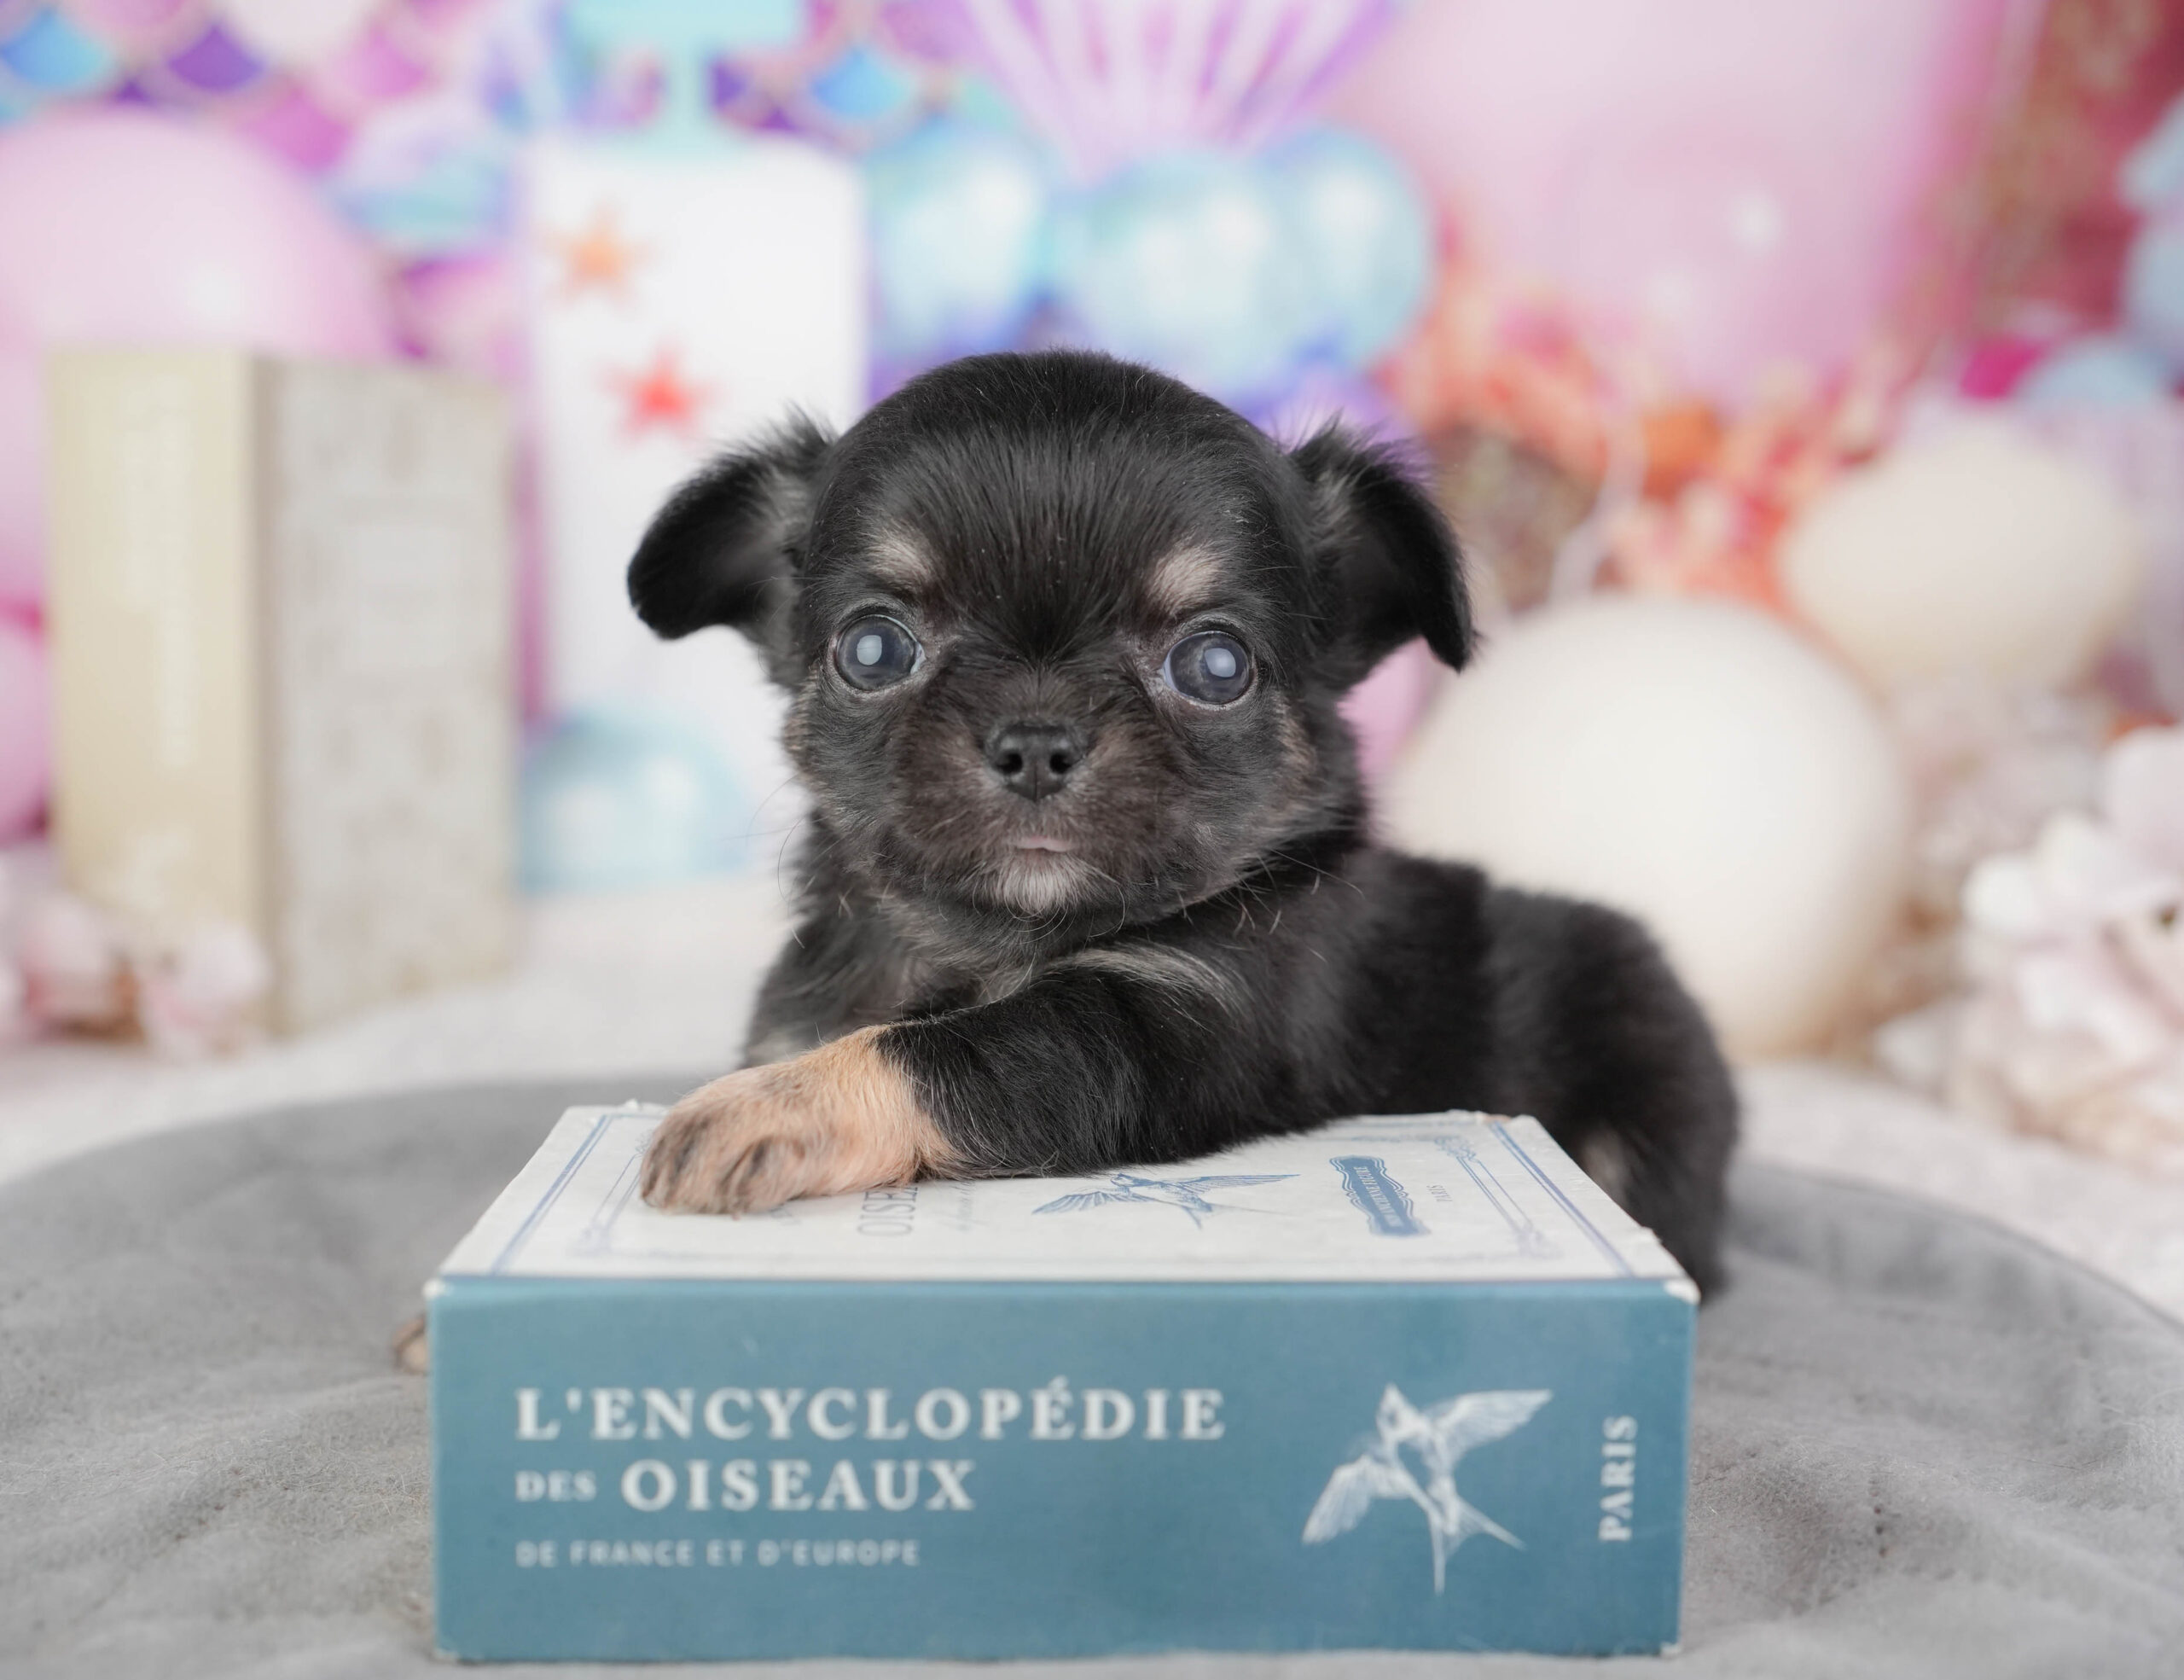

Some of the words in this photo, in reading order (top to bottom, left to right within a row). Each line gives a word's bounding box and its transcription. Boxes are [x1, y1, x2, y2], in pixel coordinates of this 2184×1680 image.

[1353, 1166, 1378, 1185] FIGURE
[857, 1187, 918, 1237] OISE
[514, 1375, 1226, 1441] L'ENCYCLOPÉDIE
[514, 1469, 596, 1503] DES
[620, 1458, 975, 1512] OISEAUX
[1598, 1415, 1638, 1542] PARIS
[515, 1539, 559, 1568] DE
[570, 1539, 695, 1567] FRANCE
[706, 1538, 746, 1567] ET
[758, 1538, 921, 1567] D'EUROPE
